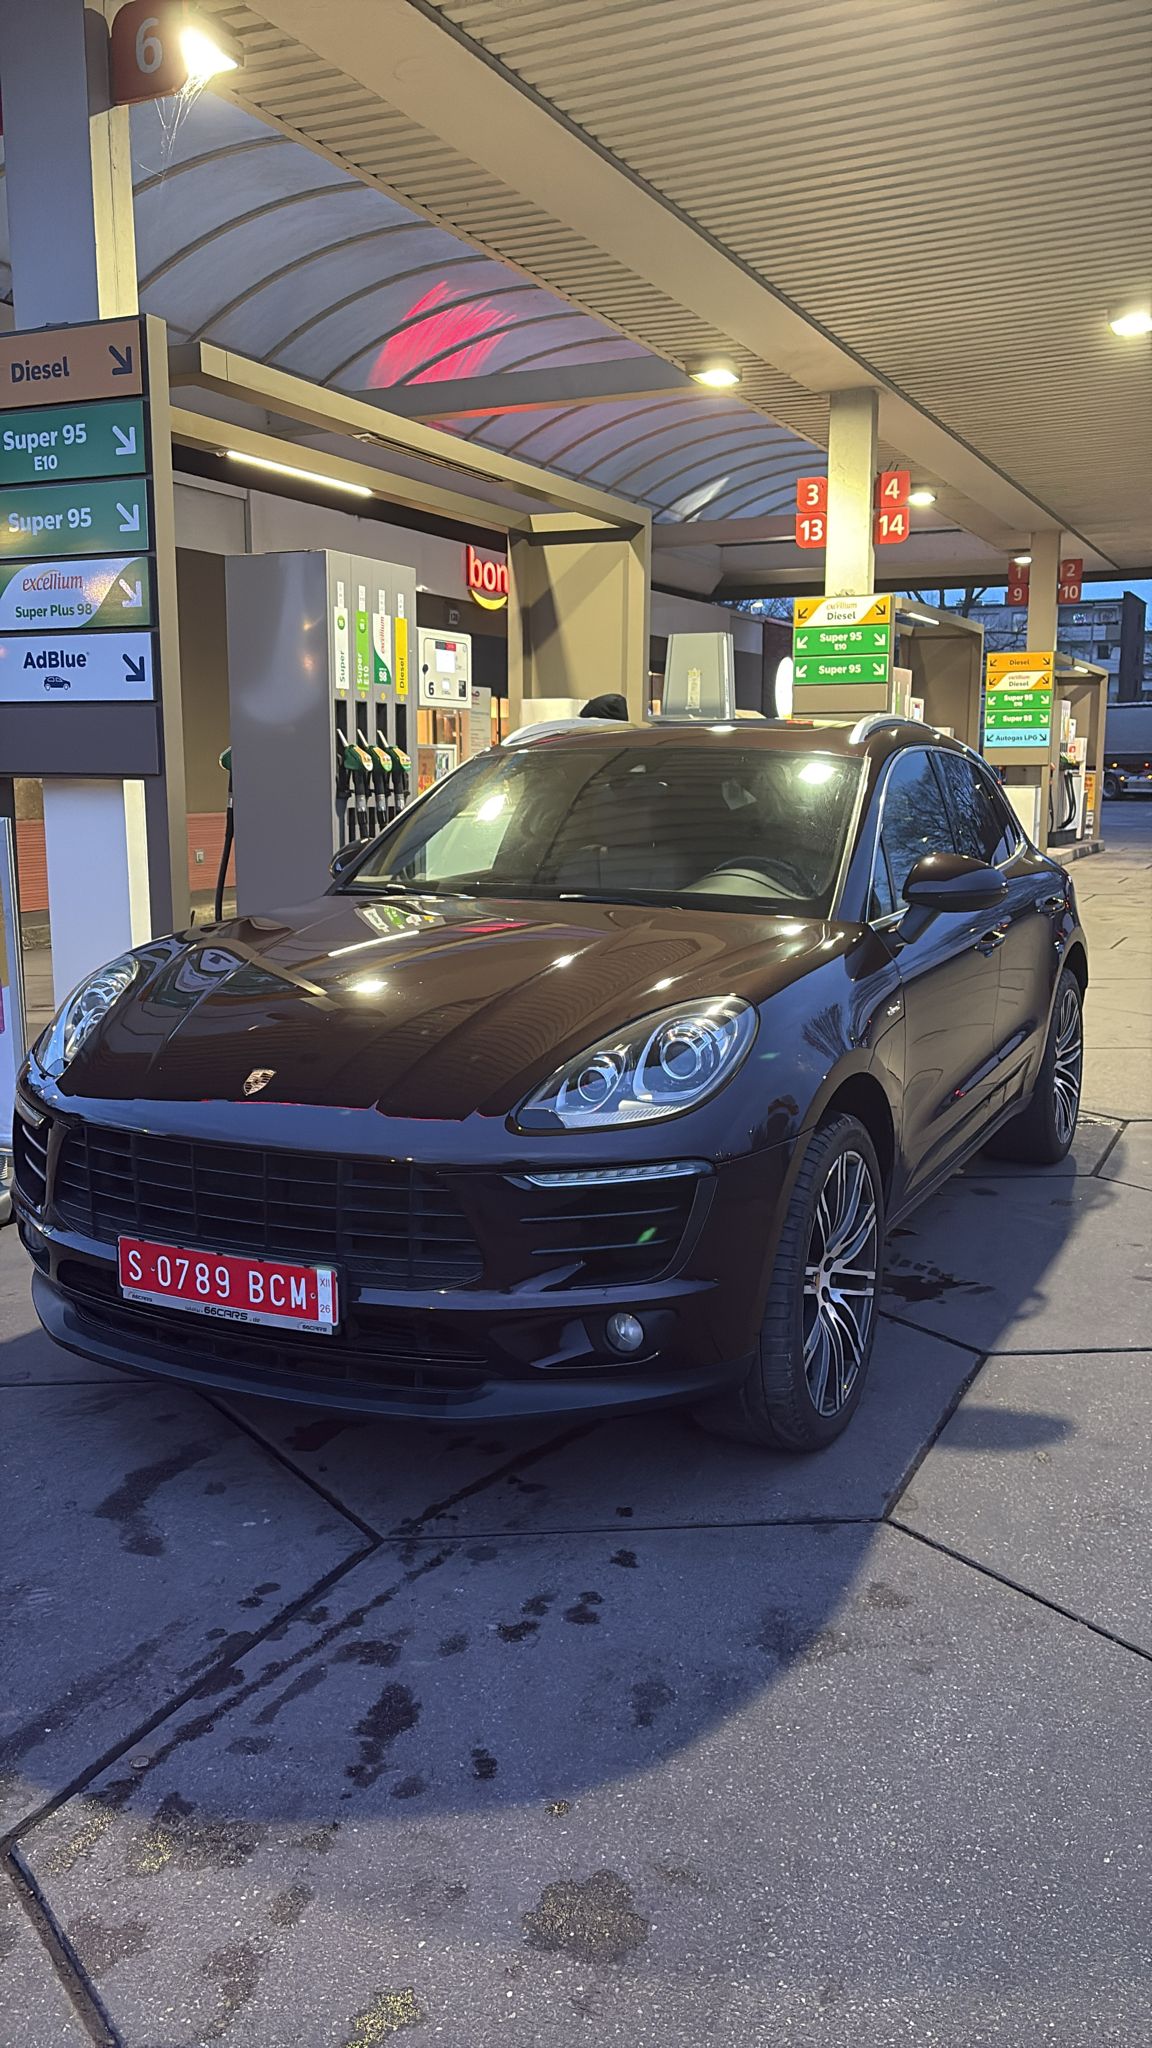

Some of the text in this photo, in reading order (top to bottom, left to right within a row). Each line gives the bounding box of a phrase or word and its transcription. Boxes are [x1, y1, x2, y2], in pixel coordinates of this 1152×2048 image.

[135, 17, 163, 74] 6
[11, 356, 70, 383] Diesel
[3, 423, 87, 454] Super 95
[34, 455, 58, 471] E10
[806, 484, 819, 505] 3
[885, 478, 900, 499] 4
[8, 507, 92, 536] Super 95
[800, 519, 823, 541] 13
[879, 514, 904, 536] 14
[467, 544, 509, 594] bon
[1015, 566, 1021, 579] 1
[1066, 563, 1076, 577] 2
[22, 572, 83, 592] excellium
[1013, 588, 1023, 601] 9
[1062, 585, 1079, 599] 10
[15, 603, 92, 620] Super Plus 98
[827, 611, 856, 620] Diesel
[820, 632, 862, 643] Super 95
[23, 651, 87, 669] AdBlue
[818, 664, 862, 676] Super 95
[428, 682, 435, 695] 6
[995, 735, 1023, 743] Autogas
[128, 1250, 306, 1310] S 0789 BCM
[320, 1304, 330, 1313] 26
